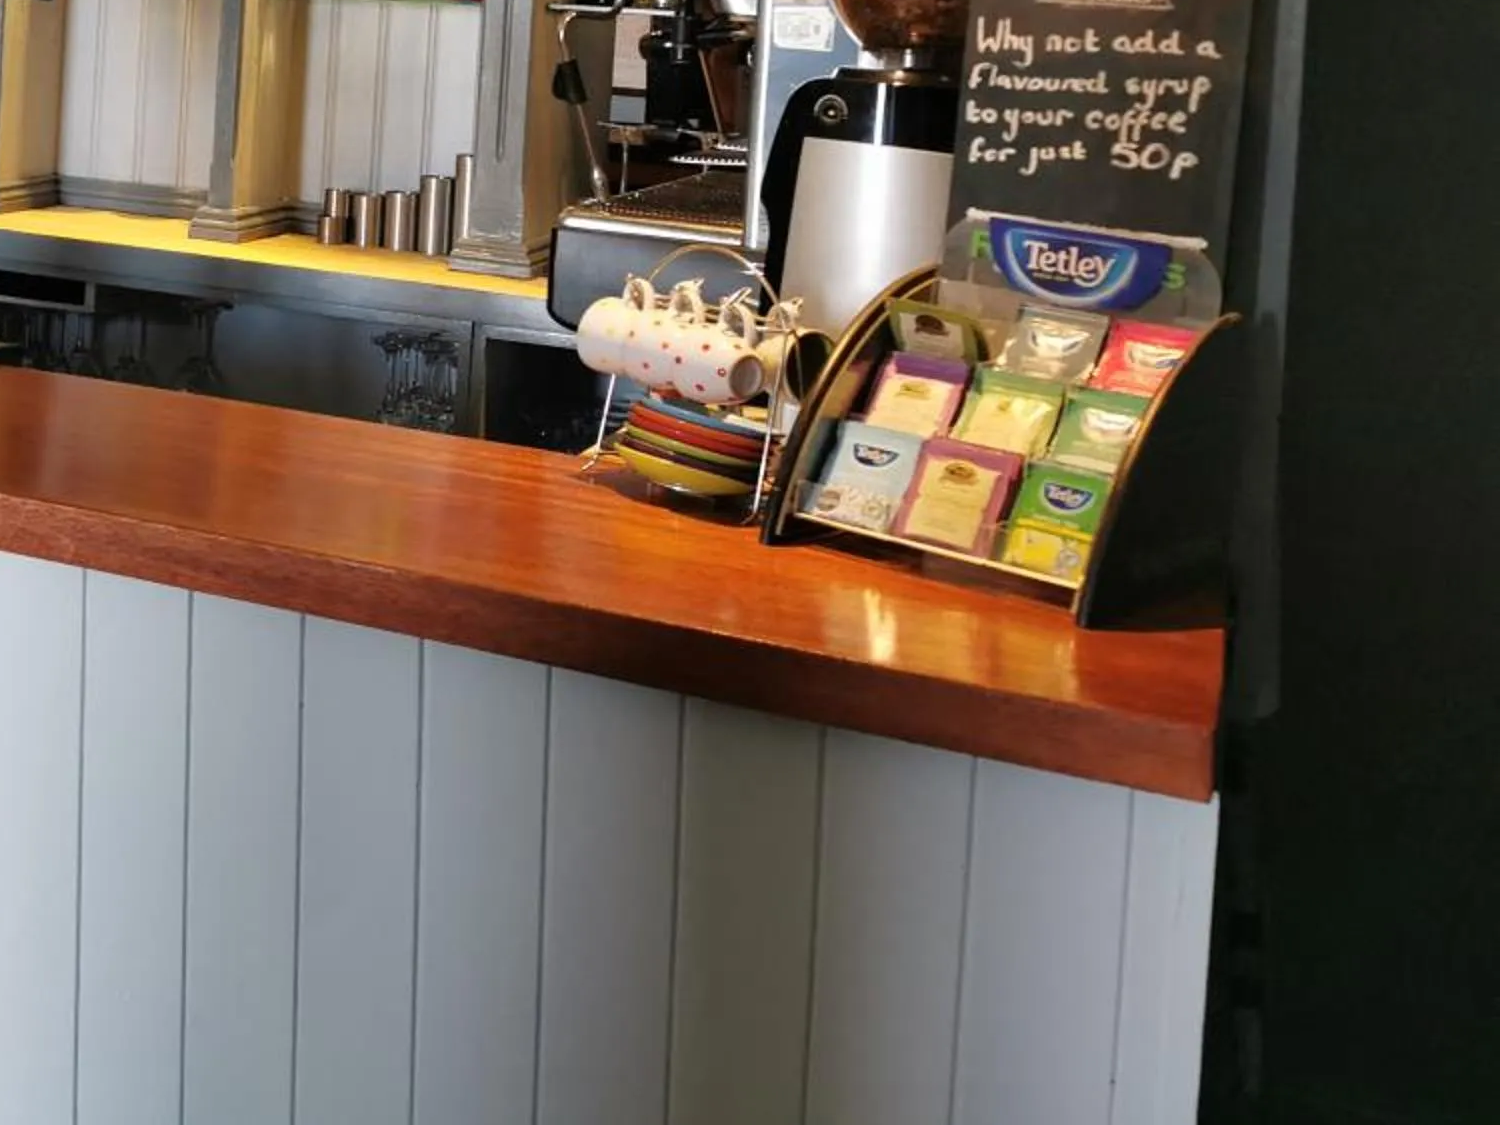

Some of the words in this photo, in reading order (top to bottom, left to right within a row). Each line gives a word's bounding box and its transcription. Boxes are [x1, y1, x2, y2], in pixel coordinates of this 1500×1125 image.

[976, 16, 1034, 68] Why
[1045, 27, 1101, 53] not
[1111, 29, 1185, 55] add
[1195, 40, 1222, 59] a
[1124, 75, 1212, 113] syrup
[965, 99, 998, 124] to
[1003, 108, 1074, 142] your
[1085, 102, 1188, 142] coffee
[967, 137, 1017, 163] for
[1019, 141, 1088, 176] just
[1109, 142, 1199, 179] 50p
[1023, 239, 1116, 288] Tetley
